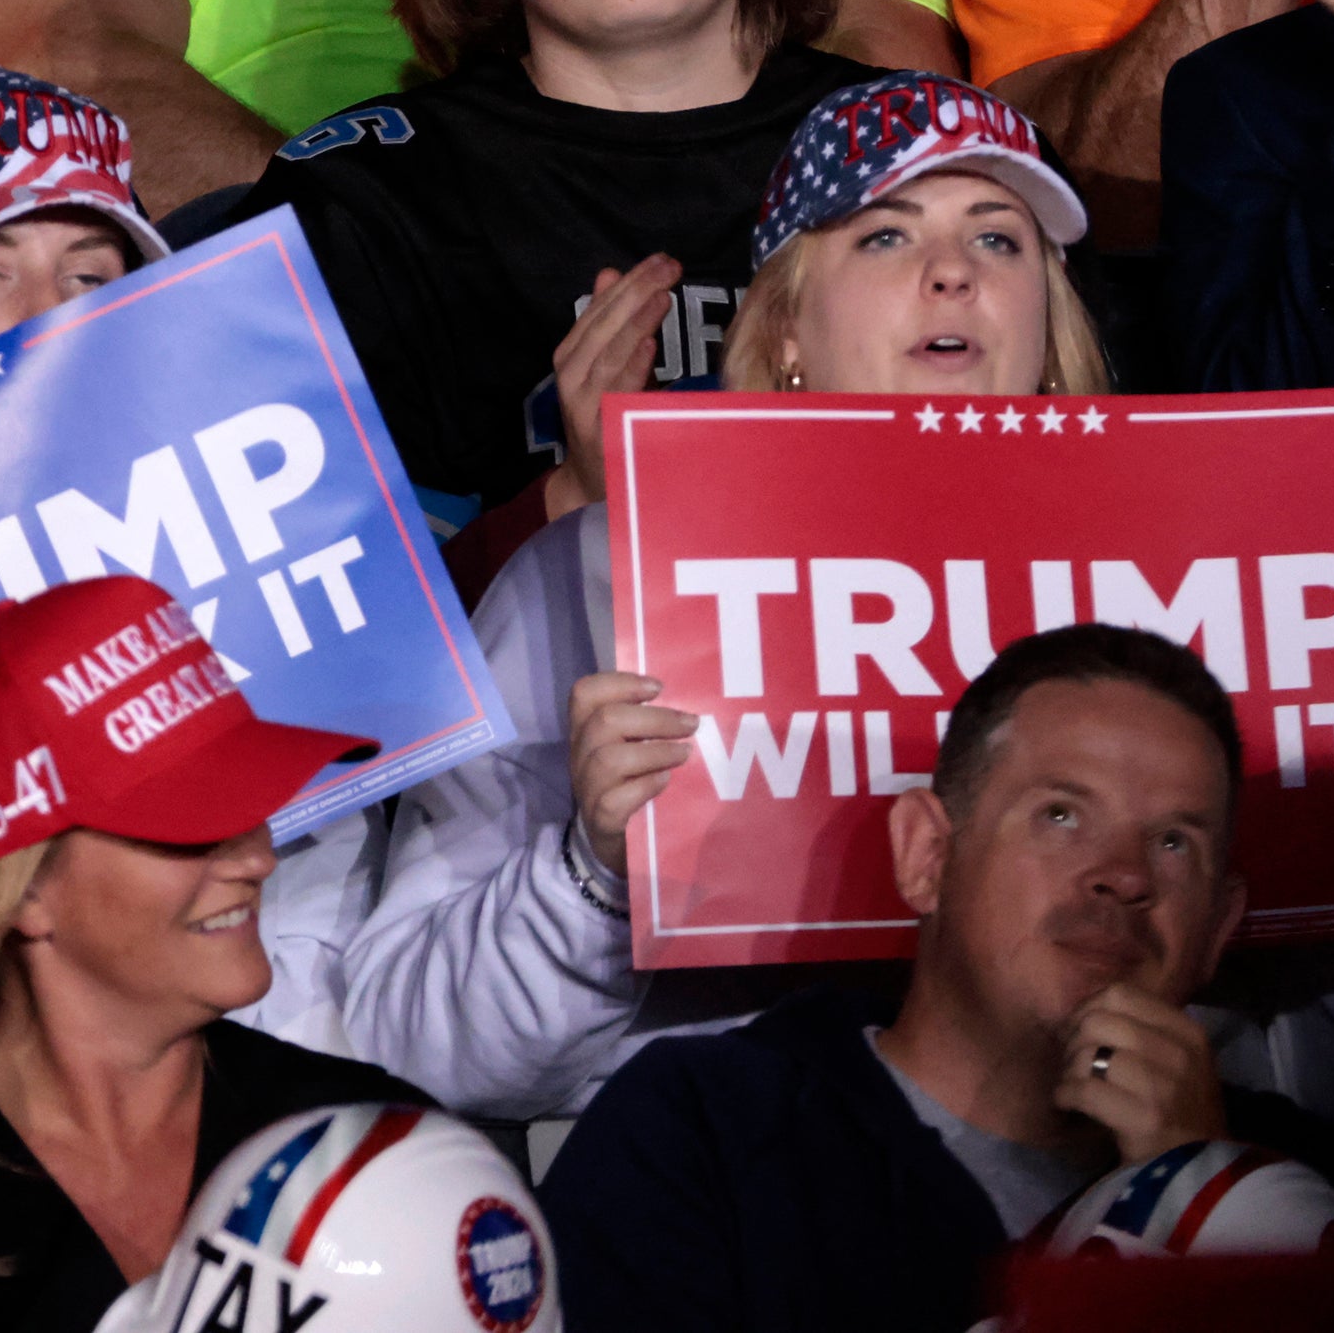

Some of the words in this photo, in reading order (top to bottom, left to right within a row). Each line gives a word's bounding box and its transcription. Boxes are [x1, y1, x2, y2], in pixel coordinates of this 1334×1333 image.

[257, 534, 365, 659] IT
[43, 623, 150, 717] MAKE
[104, 664, 207, 755] GREAT
[696, 708, 948, 802] WIL
